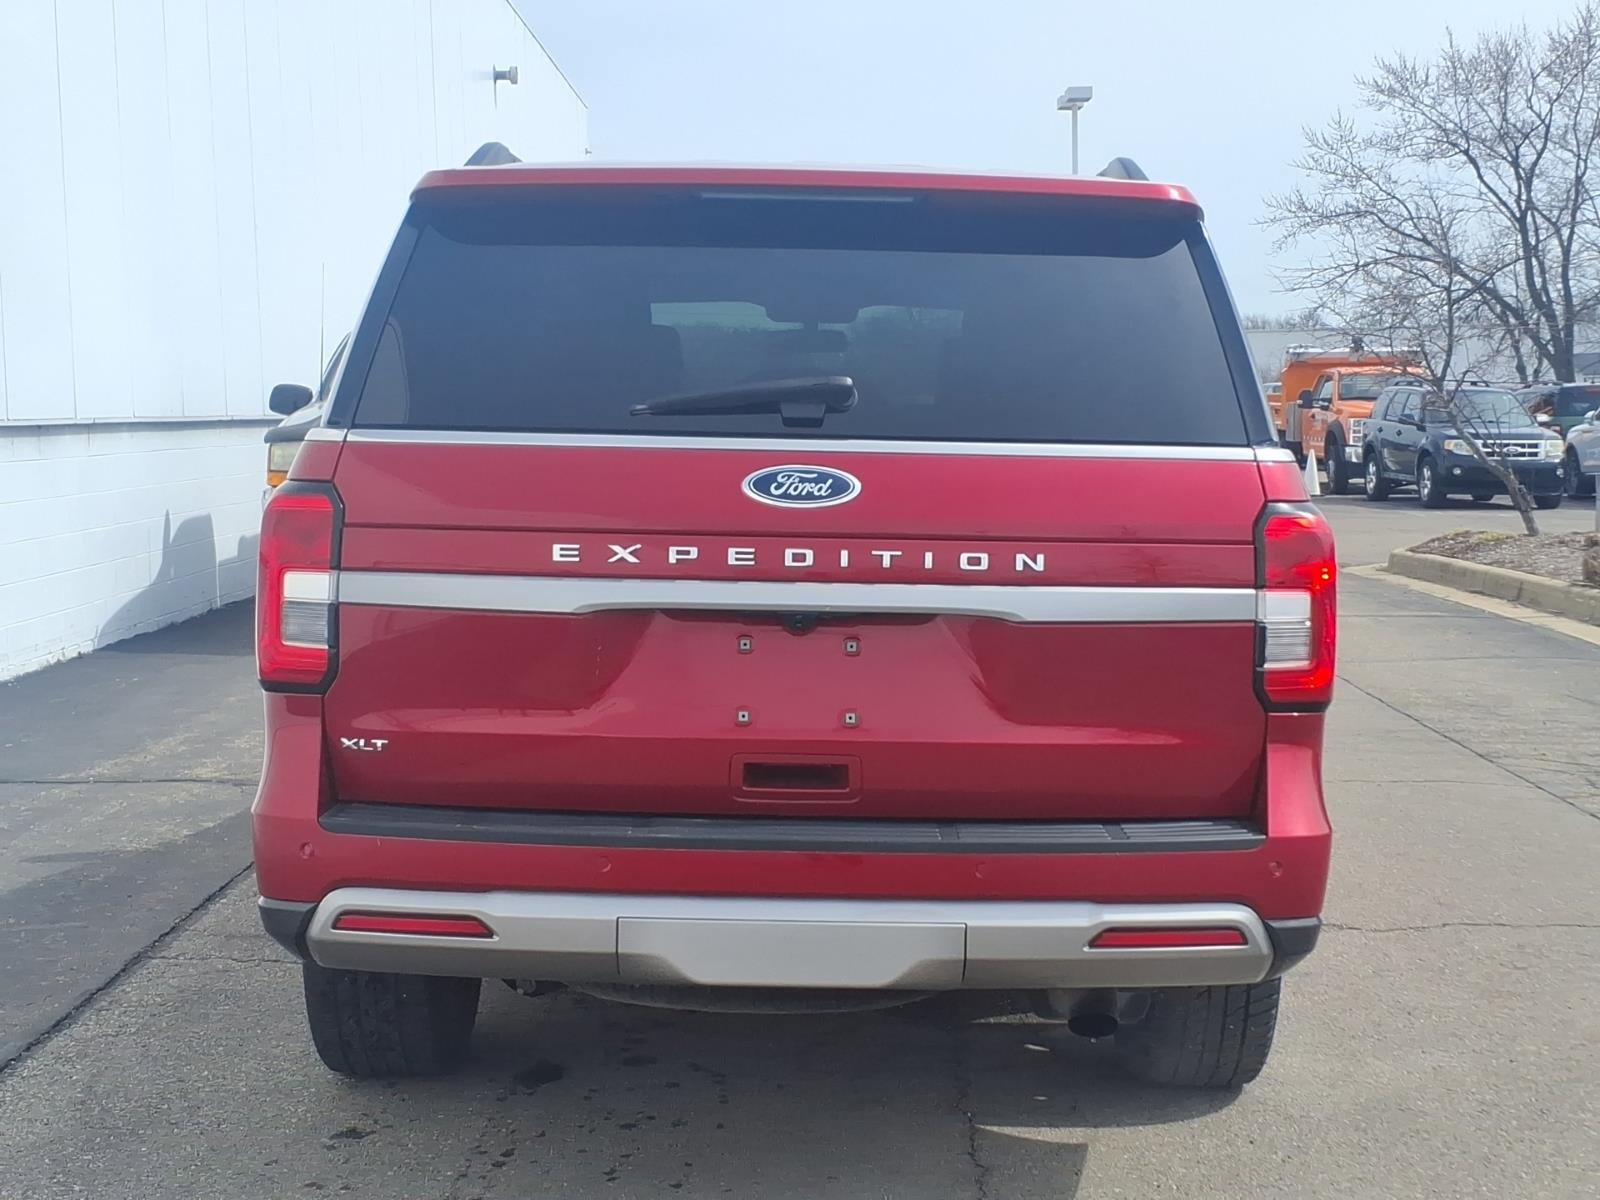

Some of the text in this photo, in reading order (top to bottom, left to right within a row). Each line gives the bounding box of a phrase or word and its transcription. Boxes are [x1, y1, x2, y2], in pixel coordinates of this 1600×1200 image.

[769, 471, 833, 497] Ford
[552, 543, 1045, 572] EXPEDITION
[340, 736, 389, 752] XLT
